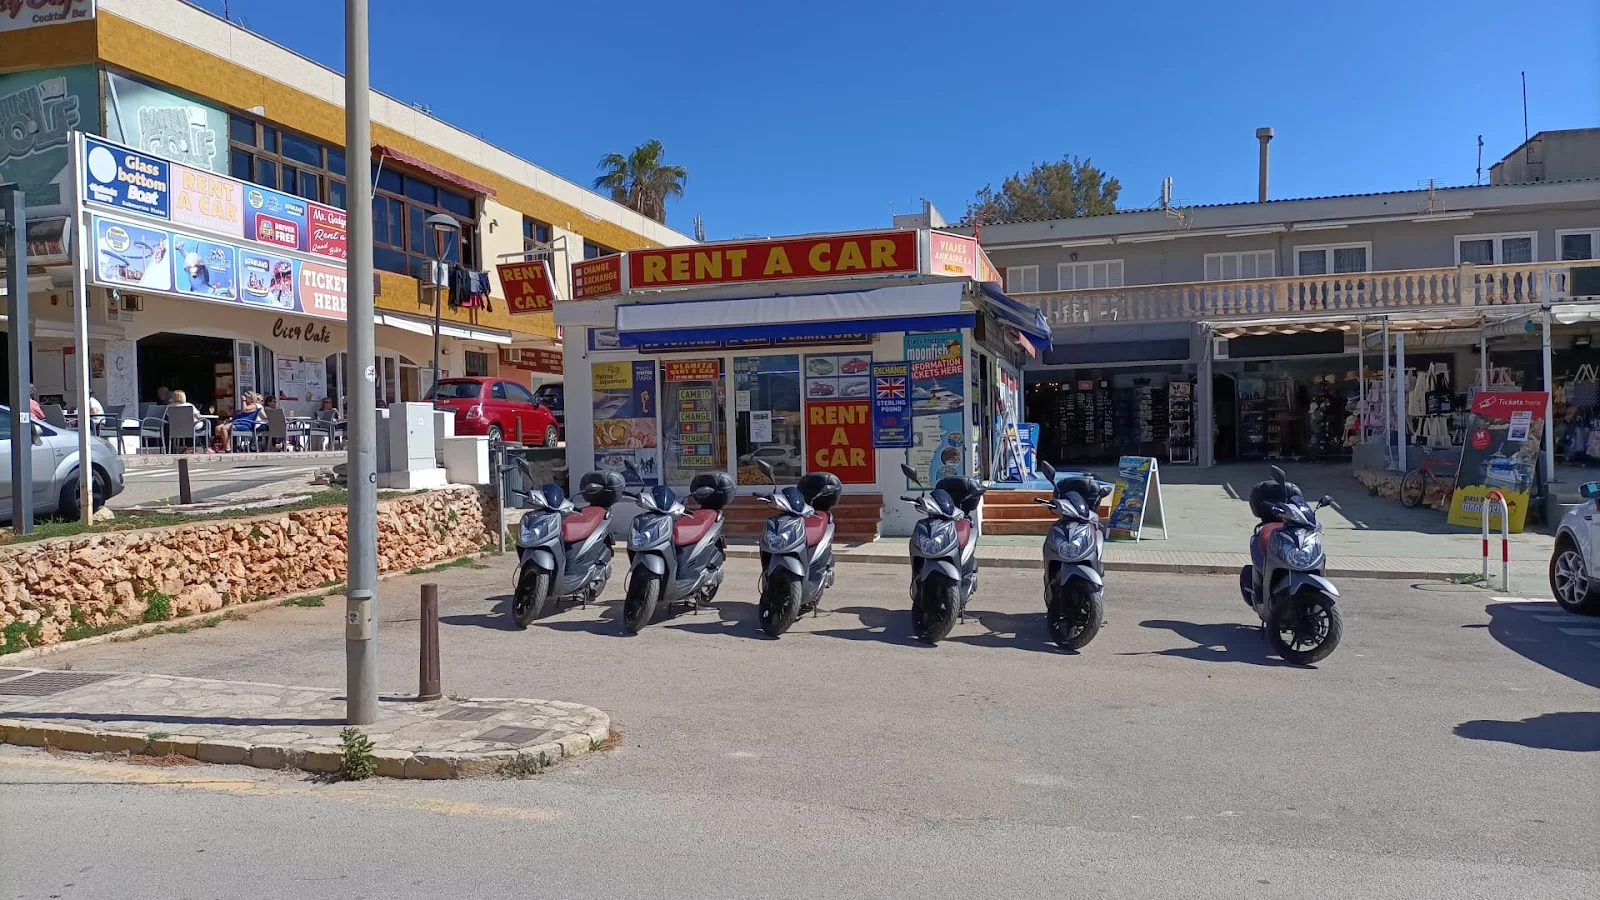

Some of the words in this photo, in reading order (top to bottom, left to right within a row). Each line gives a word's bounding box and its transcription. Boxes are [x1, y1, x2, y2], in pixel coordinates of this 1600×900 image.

[125, 155, 159, 176] Glass
[117, 166, 167, 192] bottom
[183, 171, 234, 201] RENT
[127, 184, 159, 206] Boat
[177, 191, 192, 211] A
[199, 196, 237, 222] CAR
[313, 209, 326, 221] Mr.
[275, 223, 295, 233] DRIVER
[314, 229, 339, 241] Rent
[275, 231, 295, 243] FREE
[312, 242, 329, 252] Quad
[940, 241, 967, 254] VIAJES
[643, 249, 747, 283] RENT
[763, 246, 793, 276] A
[808, 239, 898, 272] CAR
[502, 265, 543, 282] RENT
[583, 262, 610, 275] CHANGE
[583, 271, 618, 285] EXCHANGE
[522, 282, 535, 294] A
[583, 282, 612, 296] WECHSEL
[314, 292, 347, 312] HERE
[514, 295, 548, 310] CAR
[272, 317, 301, 340] City
[304, 322, 331, 343] Café
[907, 343, 948, 361] moonfish
[874, 366, 908, 375] EXCHANGE
[941, 365, 963, 375] HERE
[680, 389, 710, 399] CAMBIO
[1499, 398, 1524, 406] Tickets
[680, 412, 711, 421] CHANGE
[810, 406, 868, 425] RENT
[831, 427, 849, 445] A
[681, 456, 712, 465] WECHSEL
[815, 448, 866, 467] CAR
[1462, 502, 1503, 514] moonish
